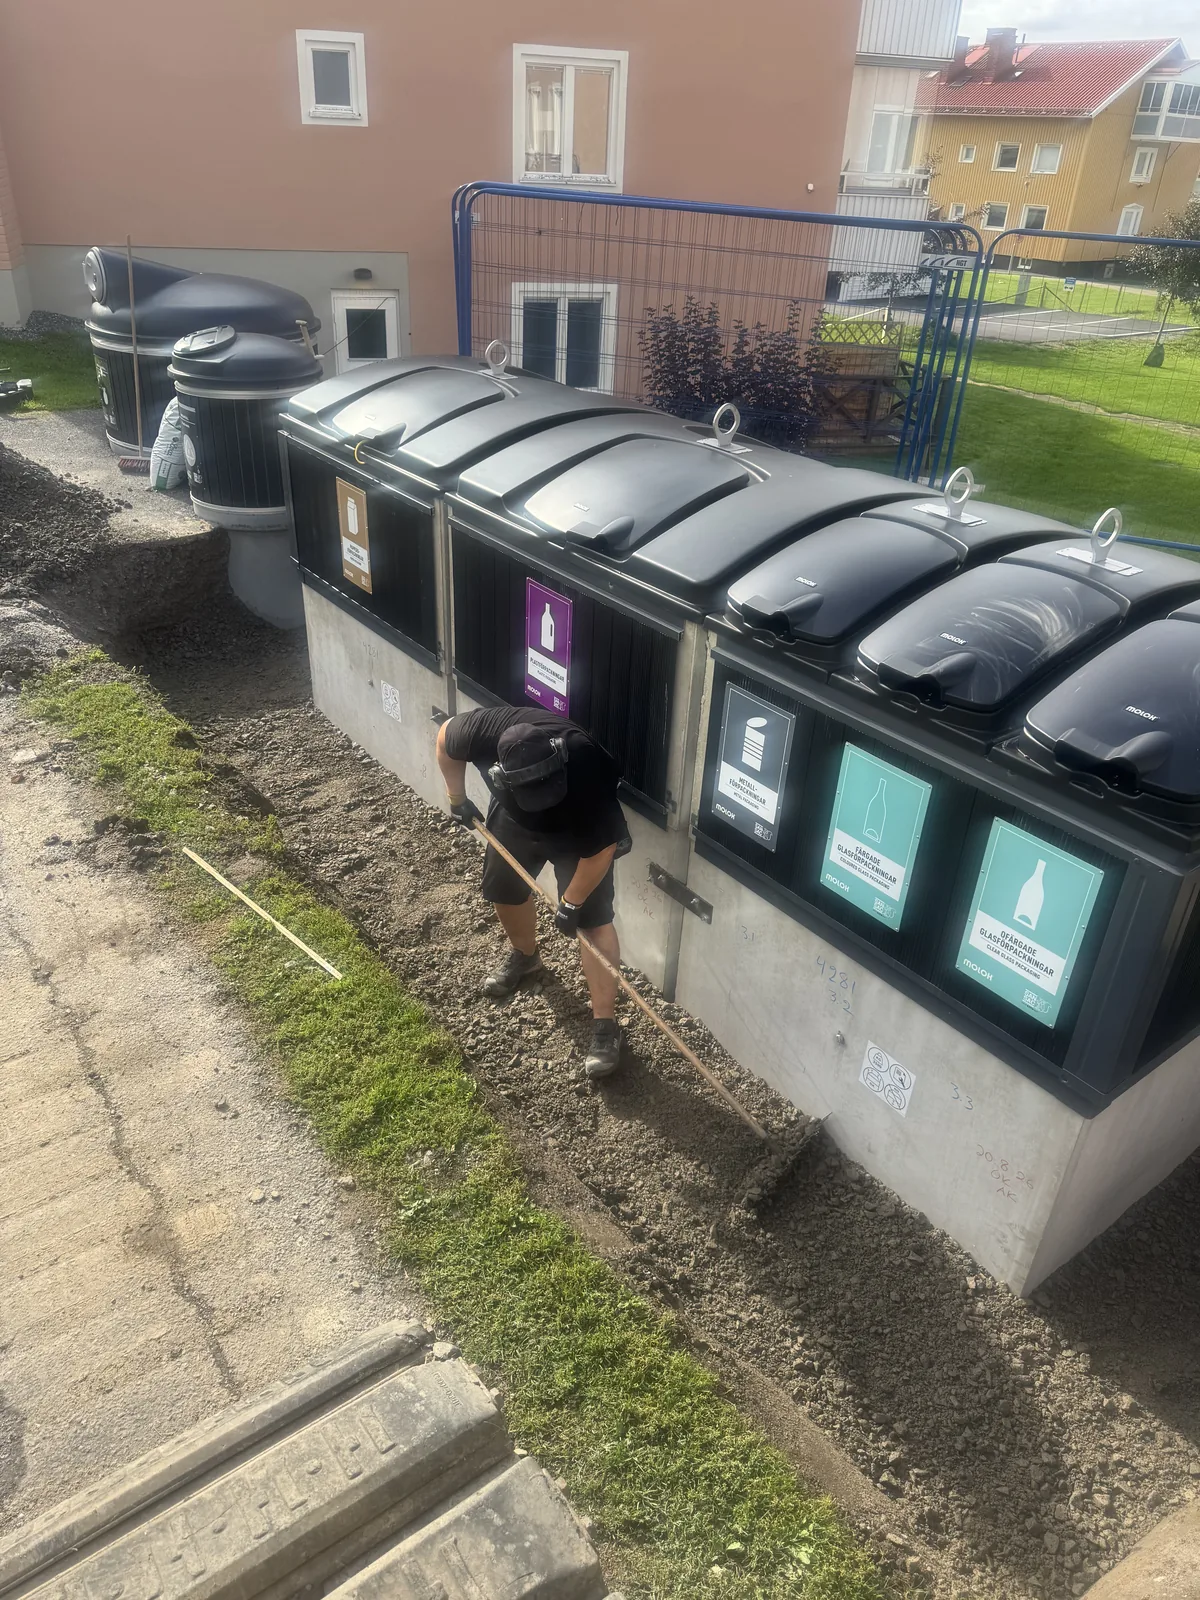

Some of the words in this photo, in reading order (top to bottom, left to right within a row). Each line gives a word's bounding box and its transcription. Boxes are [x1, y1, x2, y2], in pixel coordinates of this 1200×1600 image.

[729, 778, 766, 805] FÖRPACKNINGAR
[739, 777, 757, 791] METALL-
[837, 844, 897, 885] GLASFÖRPACKNINGAR
[855, 845, 881, 866] FÄRGADE
[857, 866, 870, 878] GLASS
[869, 873, 890, 890] PACKAGING
[979, 927, 1054, 977] GLASFÖRPACKNINGAR
[1000, 930, 1037, 957] OFÄRGADE
[816, 955, 856, 994] 4281
[986, 944, 1001, 956] CLEAR
[1000, 951, 1015, 964] GLASS
[1014, 961, 1041, 980] PACKAGING
